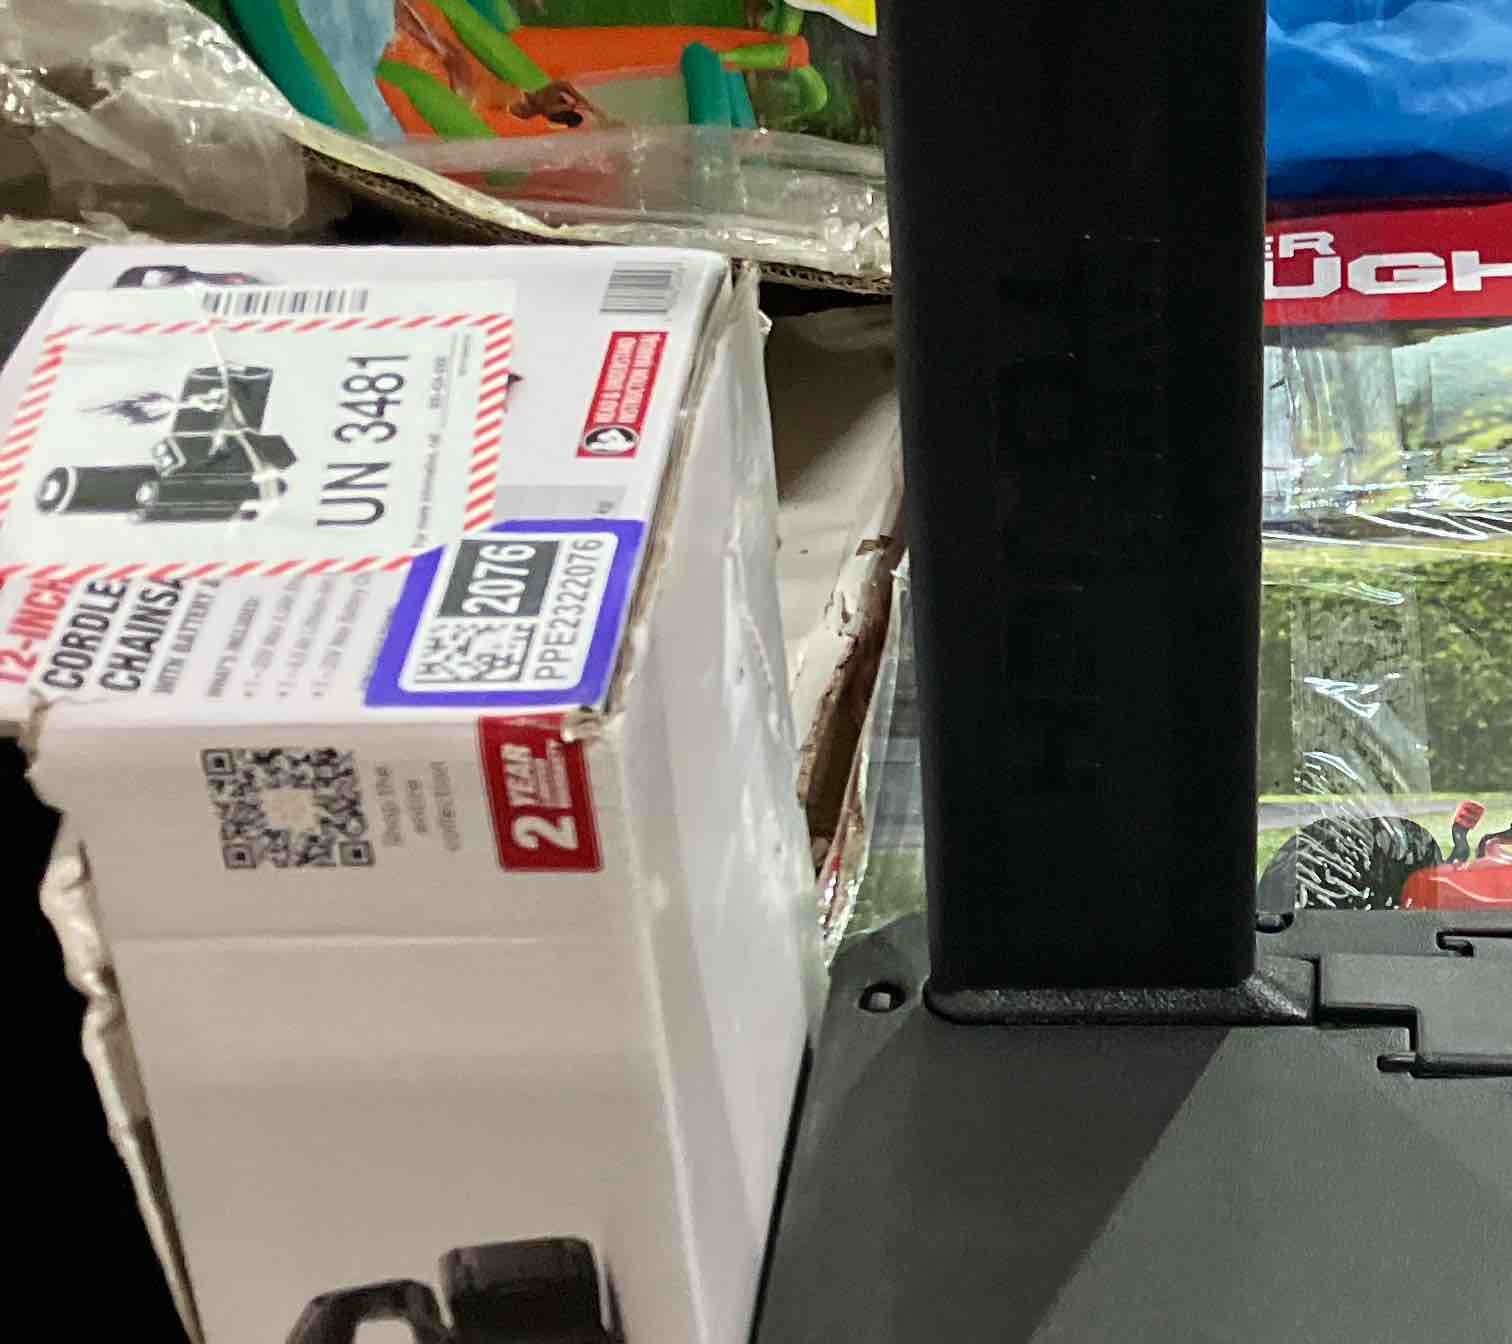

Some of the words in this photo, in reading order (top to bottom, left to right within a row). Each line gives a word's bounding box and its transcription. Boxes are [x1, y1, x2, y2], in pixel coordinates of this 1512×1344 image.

[334, 351, 412, 450] 3481
[316, 458, 388, 531] UN
[470, 542, 536, 616] 2076
[534, 536, 607, 683] PPE2322076
[0, 573, 75, 685] 12-INCH
[42, 576, 132, 691] CORDLE
[100, 576, 186, 692] CHAINSA
[152, 659, 180, 696] WITH
[172, 593, 212, 657] BATTERY
[406, 777, 429, 835] entire
[430, 759, 462, 852] collection
[501, 743, 542, 807] YEAR
[512, 815, 580, 851] 2
